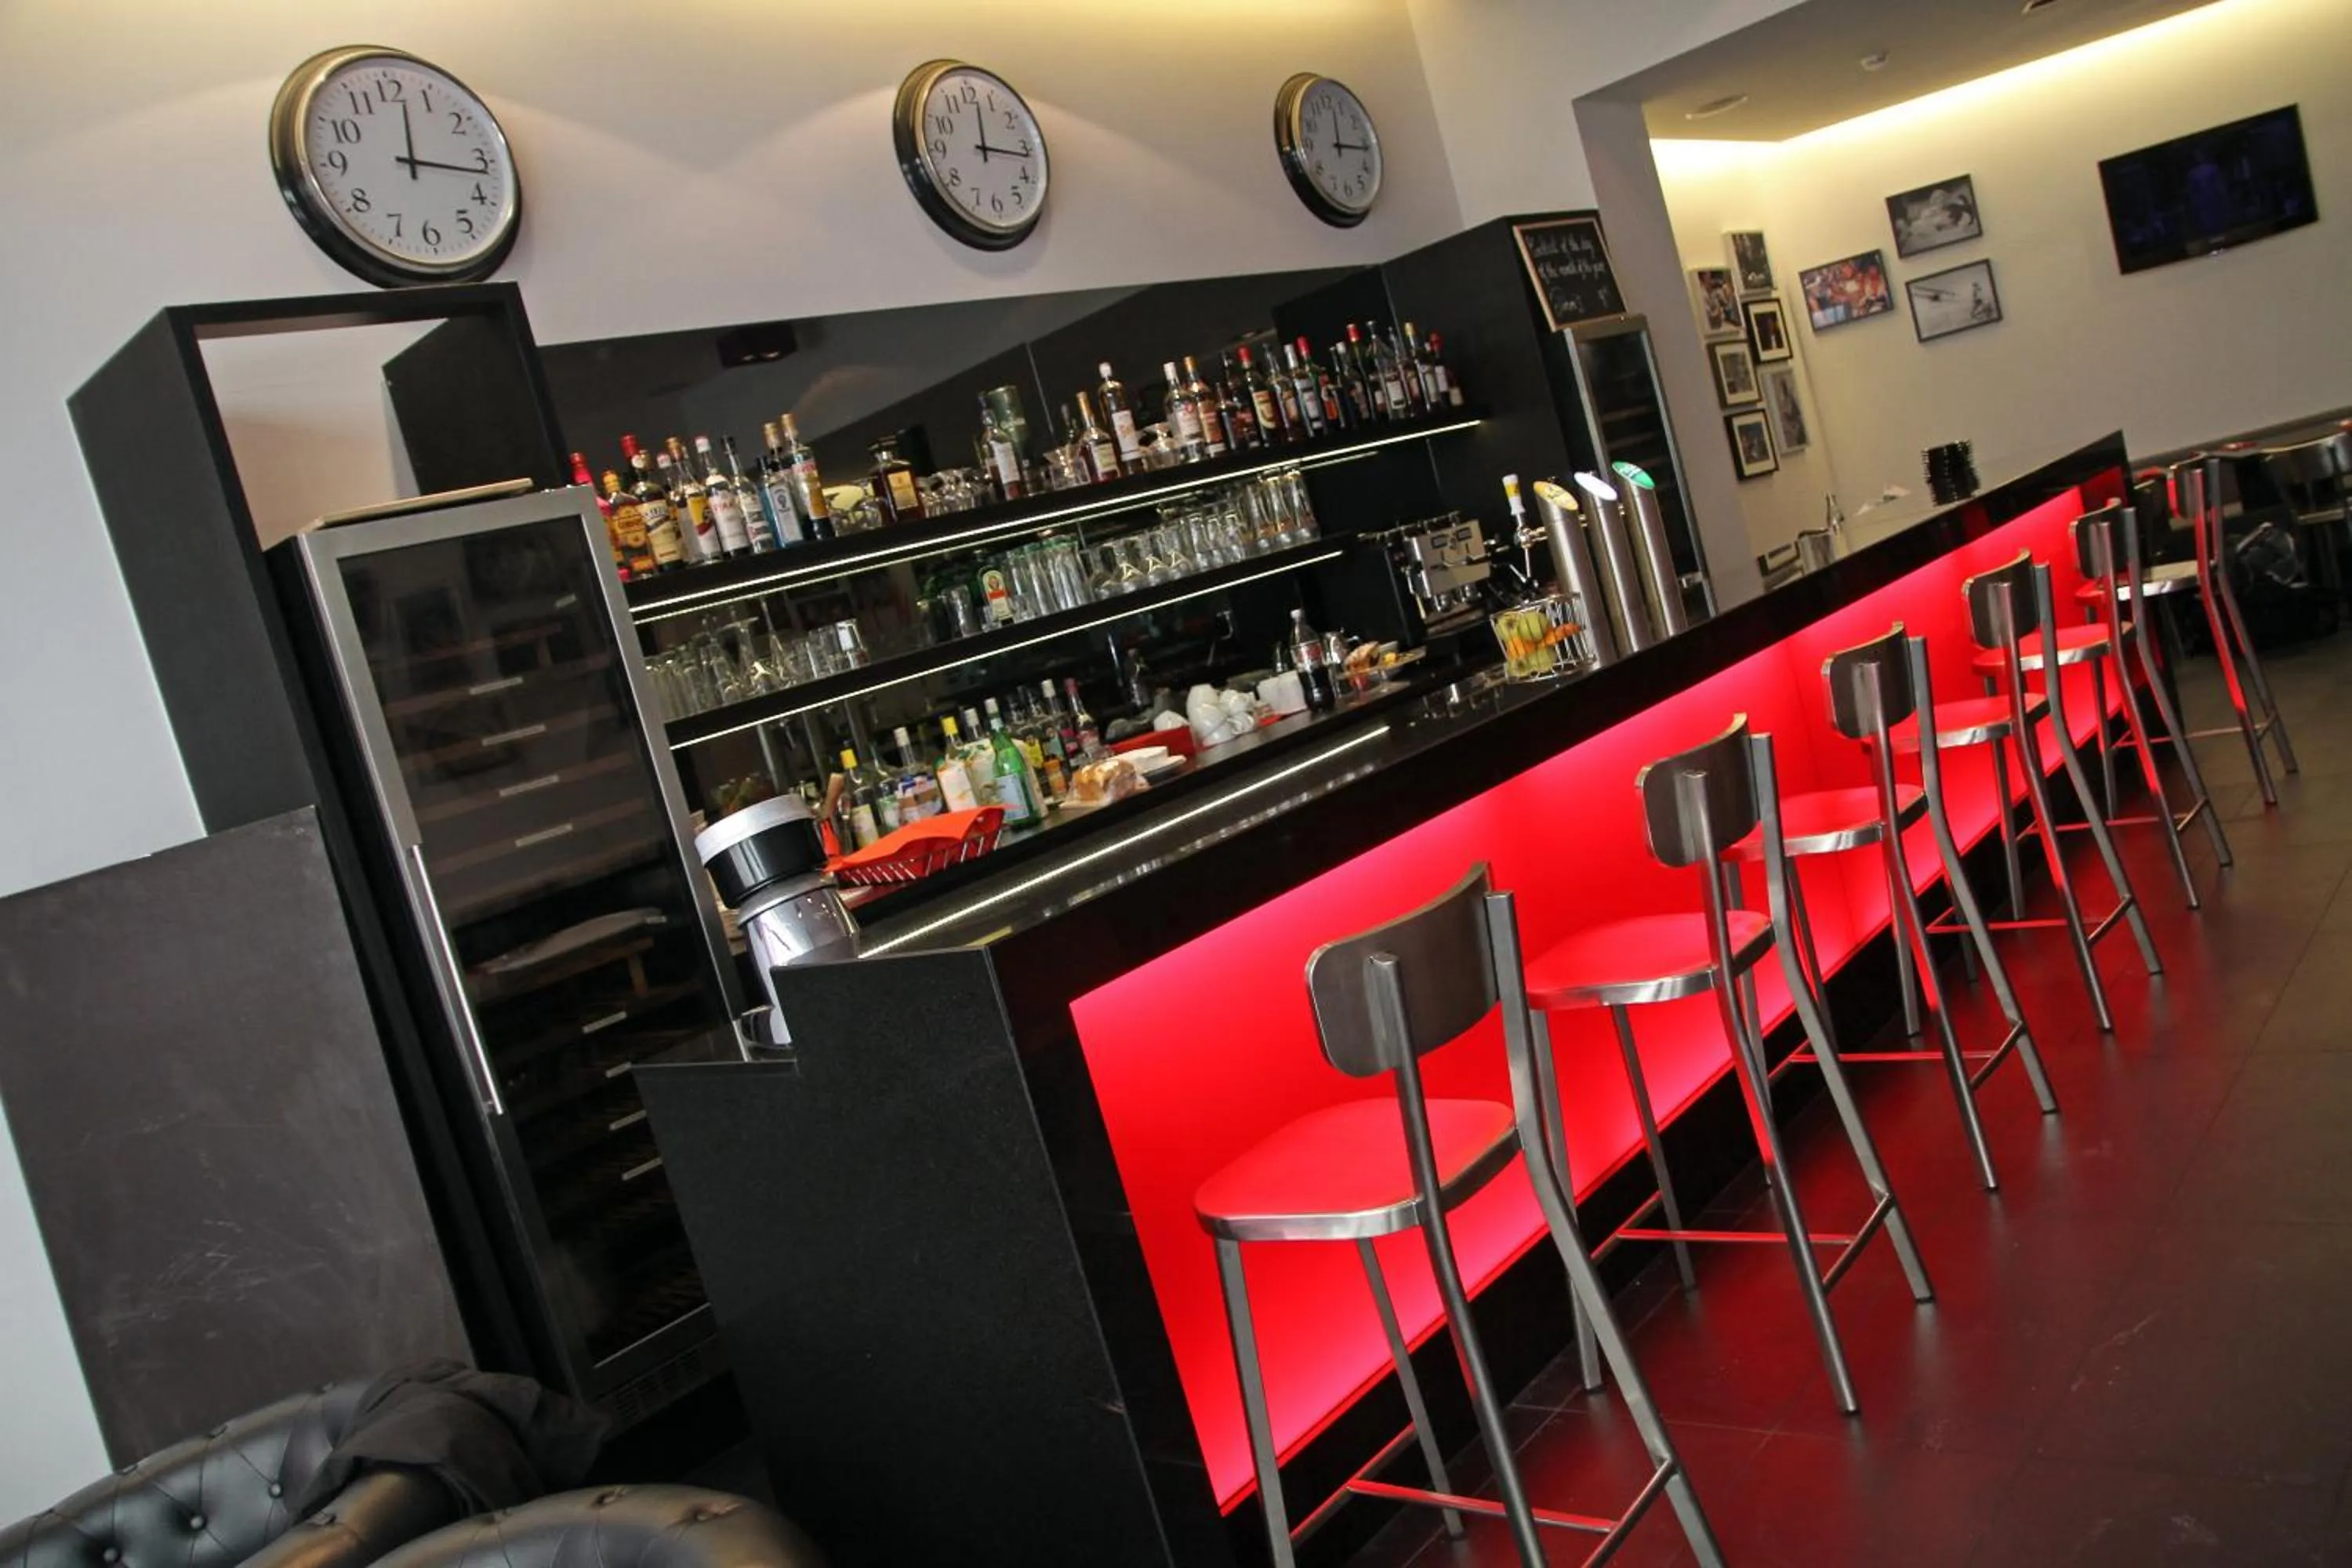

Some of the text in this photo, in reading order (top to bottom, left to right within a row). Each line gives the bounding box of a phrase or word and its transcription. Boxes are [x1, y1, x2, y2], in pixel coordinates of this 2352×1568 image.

[376, 79, 405, 103] 12
[422, 89, 432, 113] 1
[960, 85, 978, 104] 12
[987, 93, 996, 111] 1
[350, 92, 375, 114] 11
[945, 94, 960, 114] 11
[331, 118, 361, 143] 10
[449, 112, 466, 136] 2
[936, 116, 953, 136] 10
[1004, 111, 1015, 129] 2
[934, 139, 946, 158] 9
[328, 151, 347, 176] 9
[472, 148, 488, 174] 3
[949, 168, 961, 187] 8
[1019, 166, 1029, 183] 4
[351, 188, 371, 212] 8
[471, 183, 487, 205] 4
[971, 187, 980, 205] 7
[992, 194, 1003, 212] 6
[1011, 186, 1022, 205] 5
[387, 213, 402, 237] 7
[422, 220, 441, 245] 6
[456, 209, 473, 234] 5
